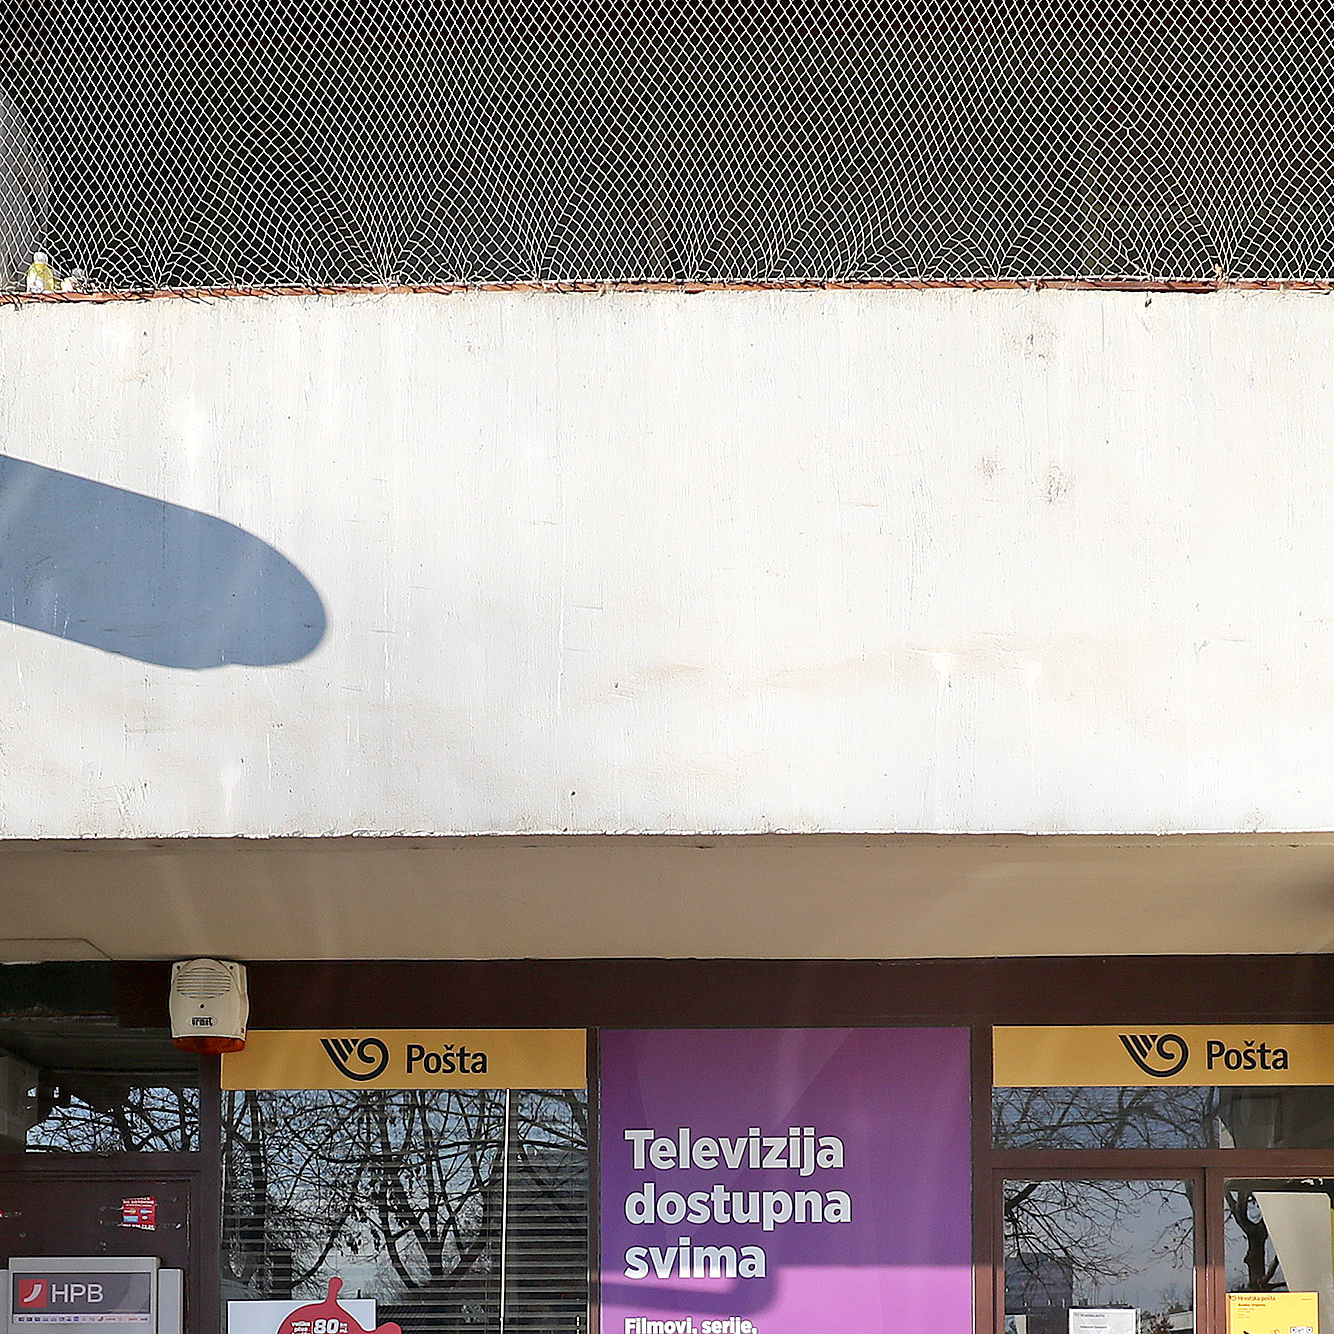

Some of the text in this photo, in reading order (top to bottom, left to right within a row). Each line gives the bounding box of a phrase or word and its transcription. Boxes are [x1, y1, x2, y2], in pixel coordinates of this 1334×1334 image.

[406, 1044, 488, 1074] Pošta
[1207, 1040, 1289, 1070] Pošta
[624, 1127, 845, 1177] Televizija
[624, 1182, 852, 1231] dostupna
[624, 1236, 766, 1279] svima
[51, 1283, 104, 1303] HPB
[313, 1318, 340, 1334] 80
